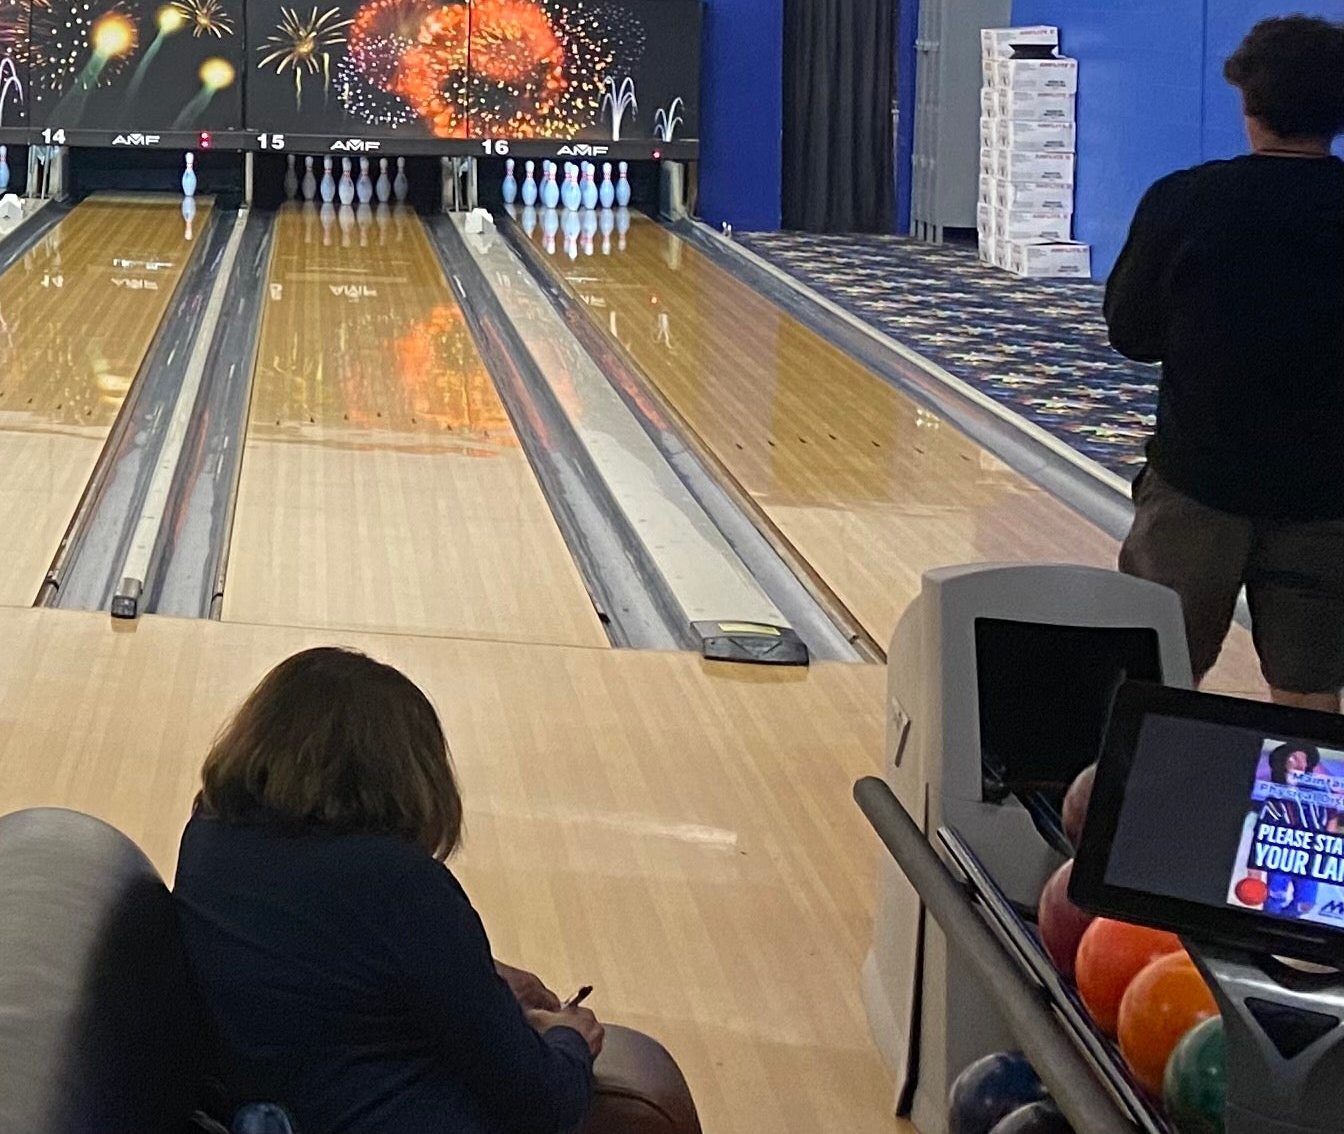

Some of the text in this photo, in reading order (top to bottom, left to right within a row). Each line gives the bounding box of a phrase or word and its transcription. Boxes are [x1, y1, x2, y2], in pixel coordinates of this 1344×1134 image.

[42, 128, 66, 145] 14
[112, 133, 161, 146] AMF
[256, 133, 285, 150] 15
[330, 138, 381, 152] AMF
[482, 139, 510, 156] 16
[556, 143, 610, 157] AMF
[1256, 823, 1313, 850] PLEASE
[1256, 842, 1310, 876] YOUR
